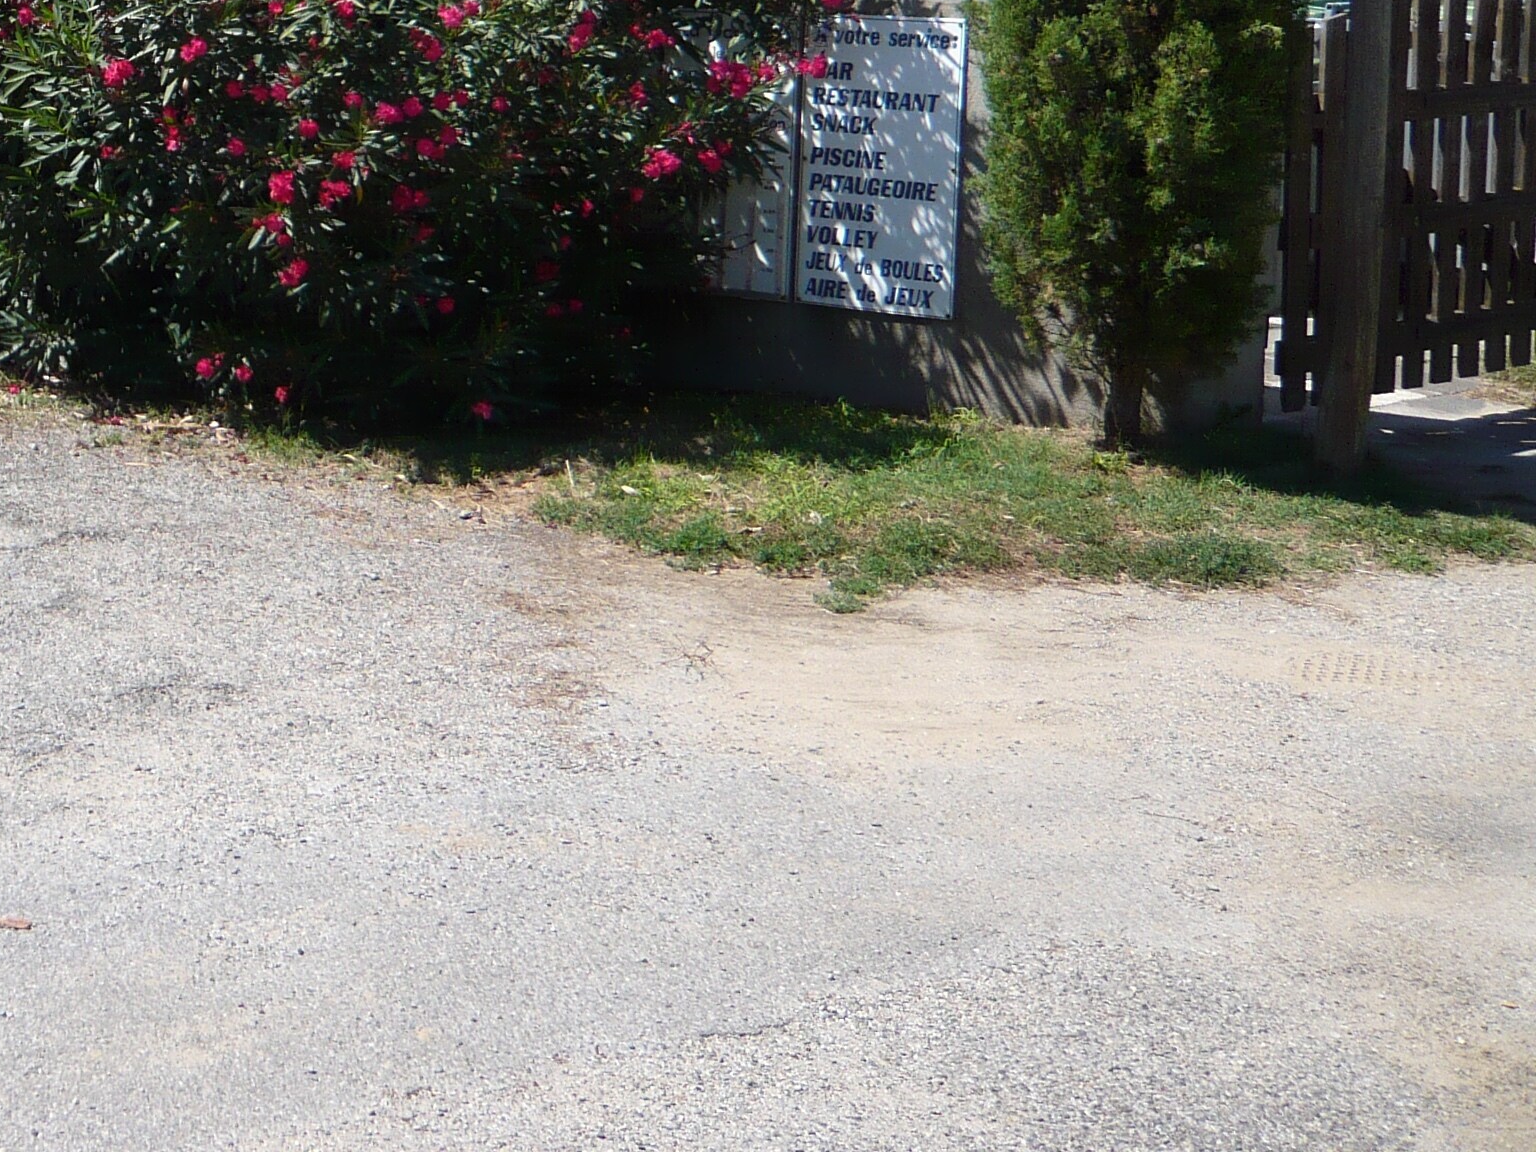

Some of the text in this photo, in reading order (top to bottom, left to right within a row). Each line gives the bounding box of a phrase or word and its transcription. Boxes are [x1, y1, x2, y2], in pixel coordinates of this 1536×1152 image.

[835, 27, 880, 46] votre
[812, 61, 853, 80] AR
[812, 87, 941, 113] RESTAURANT
[811, 112, 878, 135] SNACK
[809, 146, 887, 170] PISCINE
[809, 172, 939, 202] PATAUGEOIRE
[809, 199, 876, 223] TENNIS
[807, 224, 879, 249] VOLLEY
[806, 251, 944, 283] JEUX de BOULES
[805, 277, 934, 309] AIRE de JEUX
